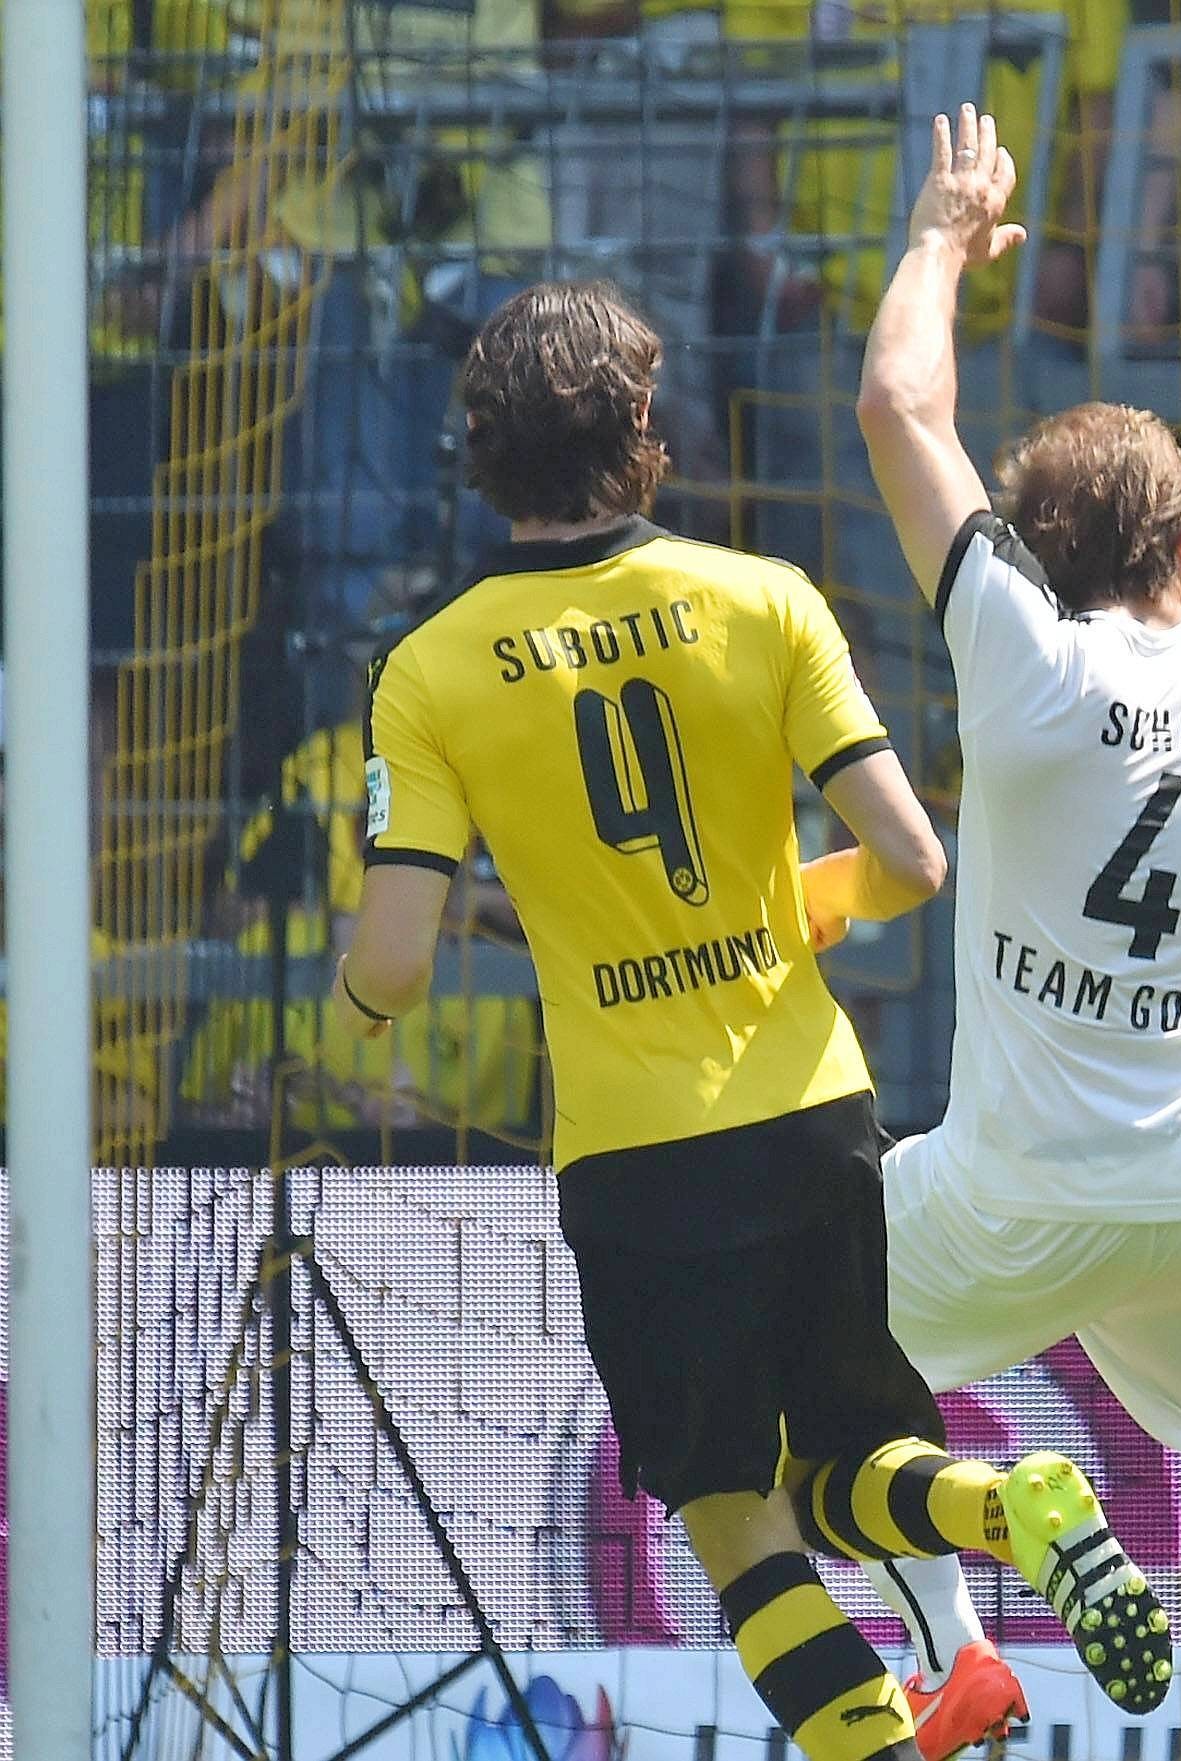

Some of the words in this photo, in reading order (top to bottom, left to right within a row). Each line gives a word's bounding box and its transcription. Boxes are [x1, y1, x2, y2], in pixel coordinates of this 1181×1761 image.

[493, 600, 699, 683] SUBOTIC
[574, 677, 709, 907] 4
[593, 927, 777, 1008] DORTMUND
[994, 930, 1113, 1020] TEAM
